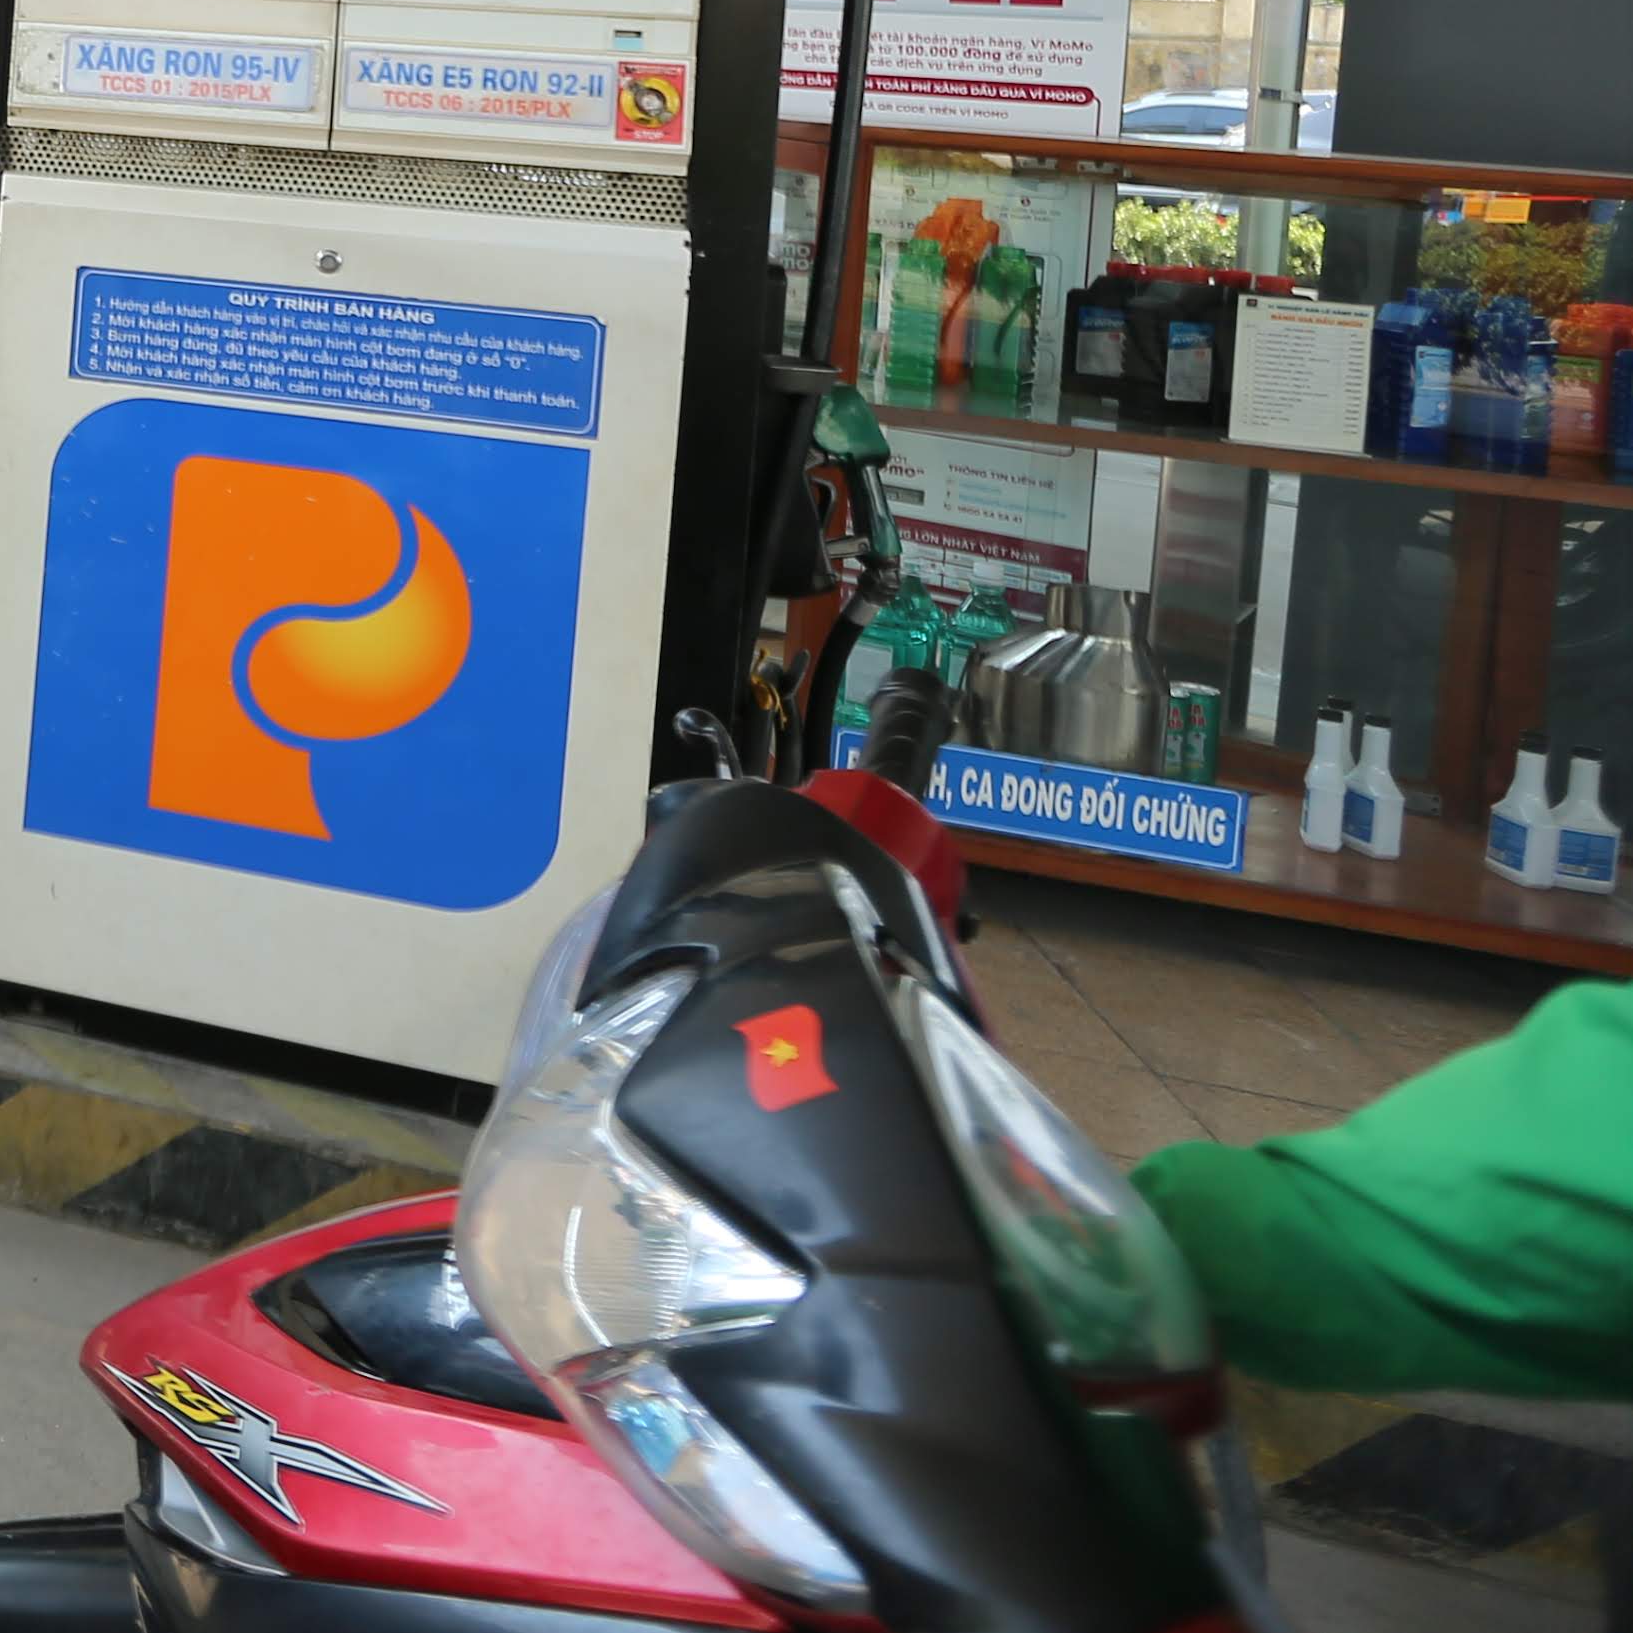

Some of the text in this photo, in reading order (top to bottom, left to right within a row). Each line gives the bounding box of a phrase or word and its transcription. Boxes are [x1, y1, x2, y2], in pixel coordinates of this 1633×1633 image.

[76, 39, 302, 84] XĂNG RON 95-IV
[897, 45, 958, 58] 100.000
[1049, 39, 1094, 52] MoMo
[100, 75, 147, 95] TCCS
[152, 79, 173, 96] 01
[357, 56, 605, 97] XĂNG E5 RON 92-II
[1045, 90, 1086, 103] MOMO
[383, 89, 433, 109] TCCS
[478, 96, 572, 119] 2015/PLX
[176, 304, 211, 319] khách
[213, 307, 243, 325] hàng
[506, 337, 545, 355] khách
[228, 292, 435, 325] QUY TRÌNH BÁN HÀNG
[90, 328, 104, 341] 3.
[108, 329, 142, 345] Bơm
[144, 332, 180, 351] hàng
[247, 342, 280, 360] theo
[282, 346, 309, 364] yêu
[311, 348, 338, 366] cầu
[341, 354, 368, 369] của
[371, 357, 417, 375] khách
[419, 361, 463, 382] hàng.
[92, 313, 105, 326] 2.
[109, 313, 136, 328] Mời
[138, 315, 180, 334] khách
[183, 321, 219, 340] hàng
[222, 325, 248, 341] xác
[251, 327, 287, 346] nhận
[290, 331, 322, 348] màn
[325, 335, 358, 352] hình
[360, 338, 383, 356] cột
[386, 341, 421, 359] bơm
[424, 345, 463, 366] đang
[89, 343, 581, 410] 4. Mời khách hàng xác nhận màn hình cột bơm trước khi thanh toán.
[106, 359, 143, 378] Nhận
[145, 363, 163, 378] và
[166, 365, 191, 382] xác
[194, 368, 230, 387] nhận
[232, 372, 251, 388] số
[287, 378, 319, 396] cảm
[345, 385, 390, 404] khách
[392, 390, 434, 411] hàng.
[960, 766, 1228, 848] CA ĐONG ĐỐI CHỨNG
